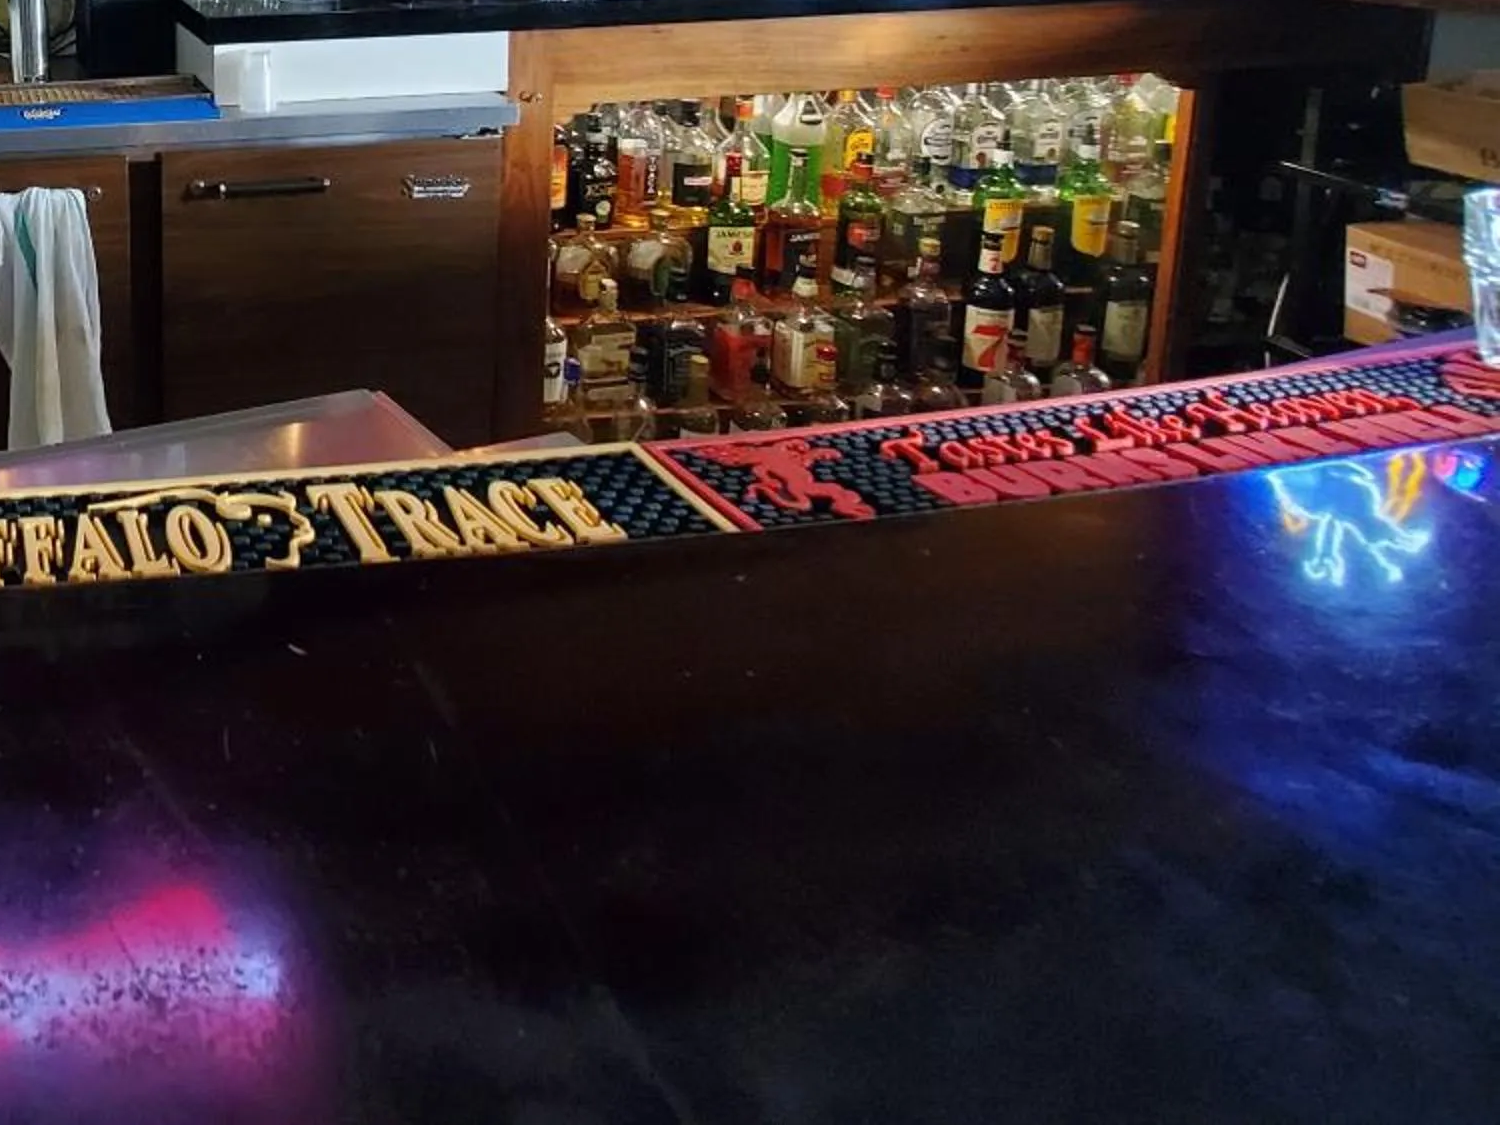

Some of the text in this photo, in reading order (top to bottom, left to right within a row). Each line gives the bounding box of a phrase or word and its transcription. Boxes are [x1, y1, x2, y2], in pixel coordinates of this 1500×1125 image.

[880, 426, 1074, 473] Tastes
[1074, 403, 1201, 453] Like
[306, 476, 627, 564] TRACE
